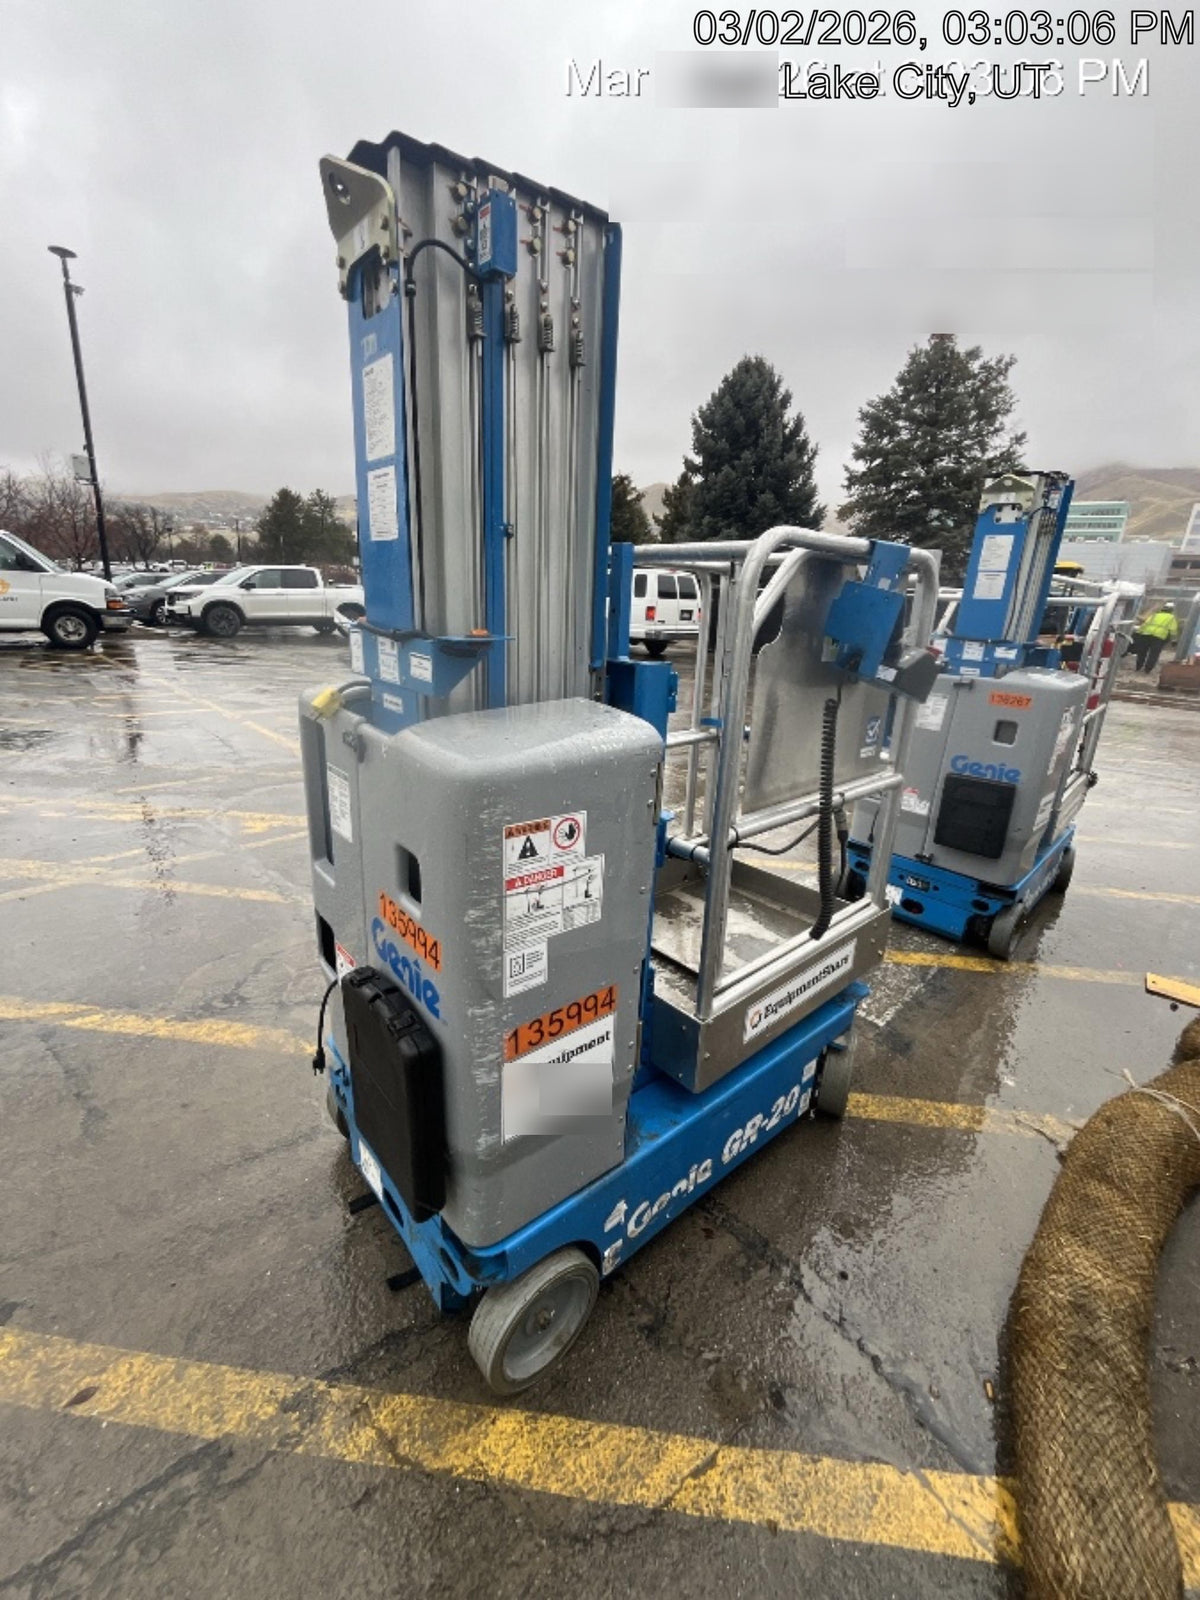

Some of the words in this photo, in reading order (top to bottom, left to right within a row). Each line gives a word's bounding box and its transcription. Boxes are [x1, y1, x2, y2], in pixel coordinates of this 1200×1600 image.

[951, 755, 1021, 783] Genie
[371, 916, 441, 1020] Genie
[379, 892, 440, 970] 135994
[507, 985, 616, 1056] 135994
[548, 1030, 611, 1064] uipment
[627, 1158, 713, 1239] Genie
[722, 1084, 800, 1165] GR-20
